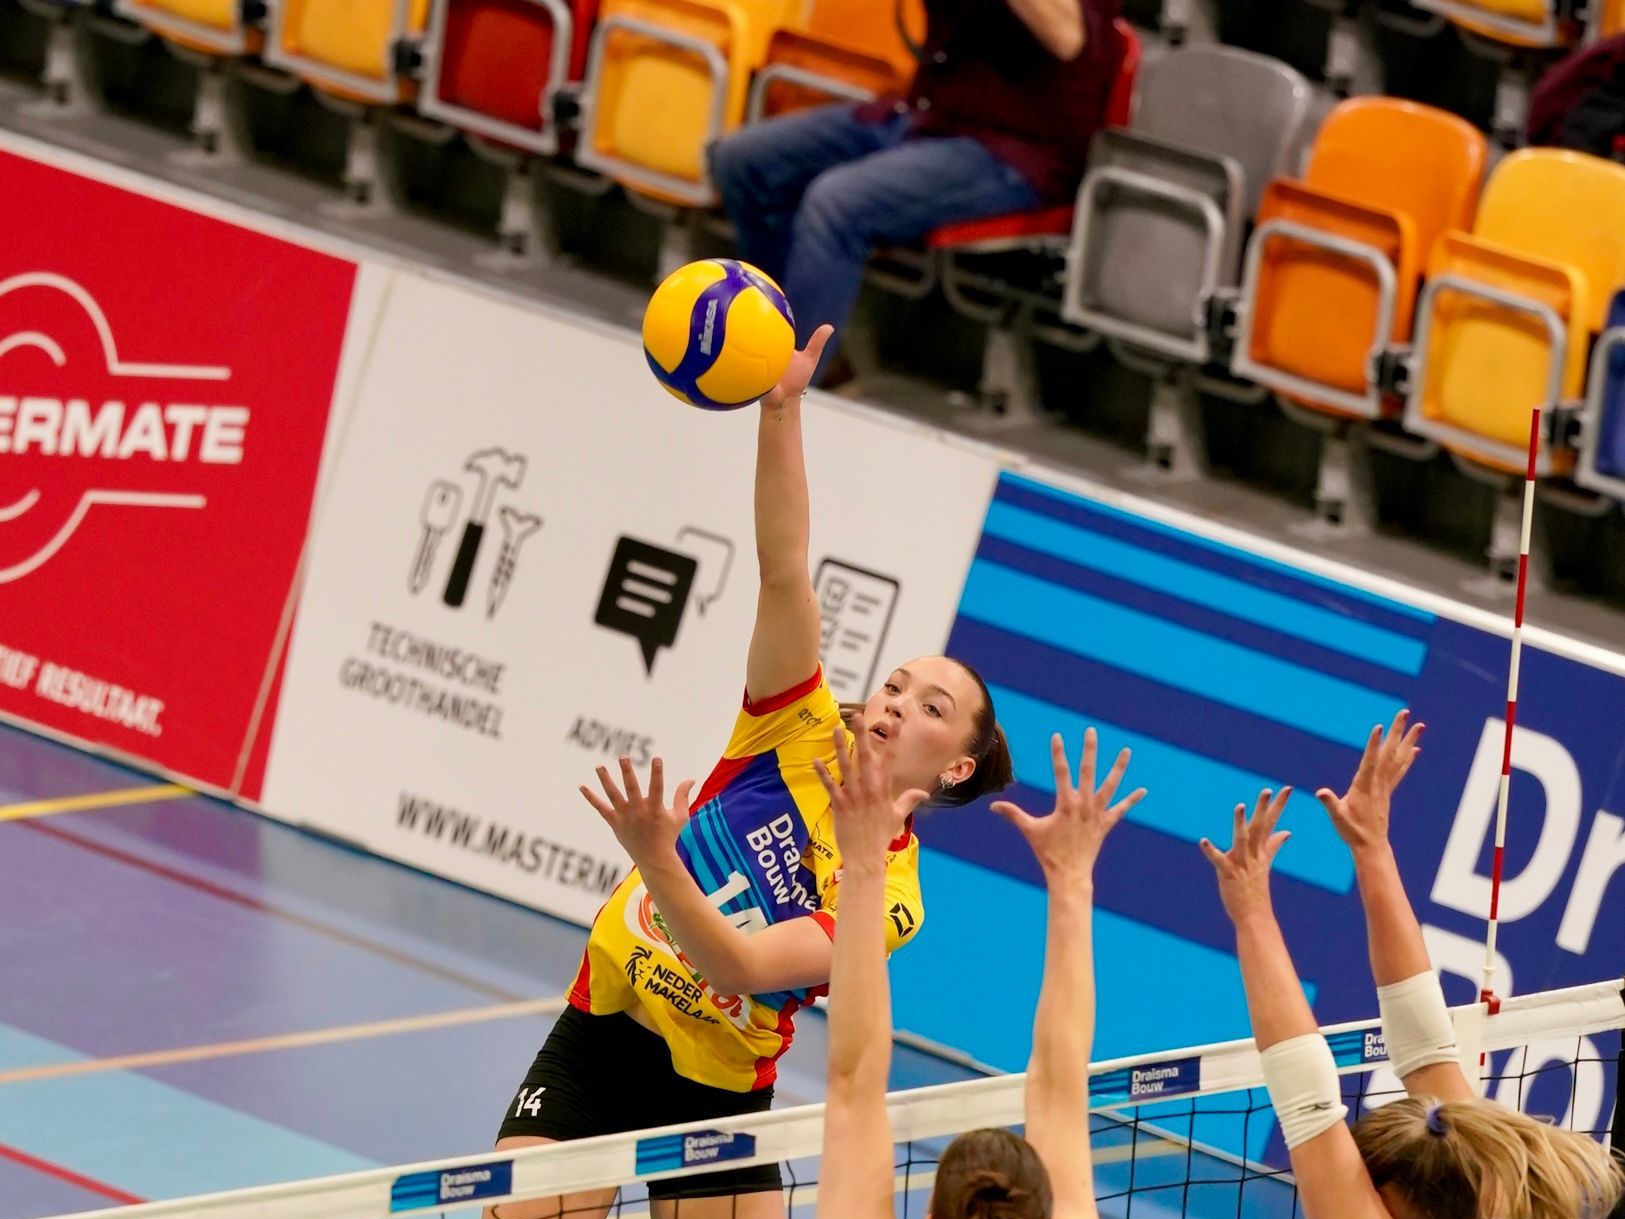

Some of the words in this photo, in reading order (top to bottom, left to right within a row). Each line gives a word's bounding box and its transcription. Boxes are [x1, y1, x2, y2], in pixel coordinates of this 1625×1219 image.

[367, 620, 506, 695] TECHNISCHE
[338, 656, 504, 739] GROOTHANDEL
[565, 714, 655, 768] ADVIES
[746, 825, 790, 906] Bouw
[768, 812, 818, 913] Draima
[652, 963, 703, 1004] NEDER
[1131, 1080, 1165, 1096] Bouw
[1132, 1066, 1180, 1083] Draisma
[515, 1086, 547, 1118] 14
[684, 1146, 720, 1162] Bouw
[440, 1184, 476, 1200] Bouw
[441, 1169, 492, 1187] Draisma
